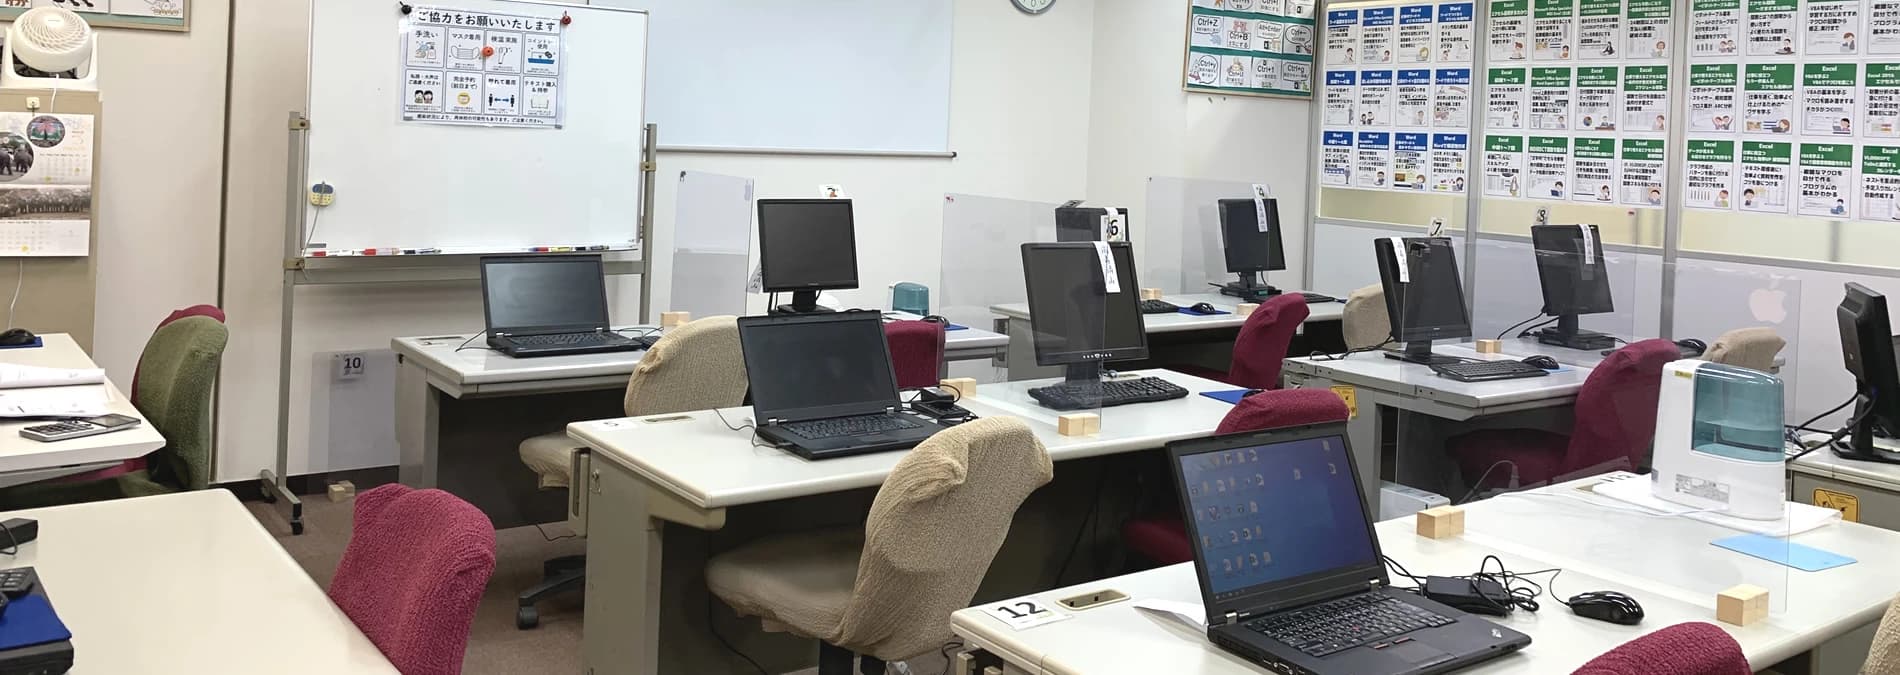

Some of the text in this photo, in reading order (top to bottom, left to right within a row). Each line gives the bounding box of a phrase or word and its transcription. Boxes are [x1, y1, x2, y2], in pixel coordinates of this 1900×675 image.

[418, 11, 556, 32] ご協力をお願いいたします
[1197, 18, 1218, 27] Ctrl+Z
[415, 30, 438, 38] 手洗い
[452, 33, 481, 41] マスク着用
[1229, 32, 1248, 41] Ctrl+B
[1110, 219, 1119, 236] 6
[1434, 222, 1442, 236] 7
[344, 356, 361, 369] 10
[998, 602, 1048, 618] 12
